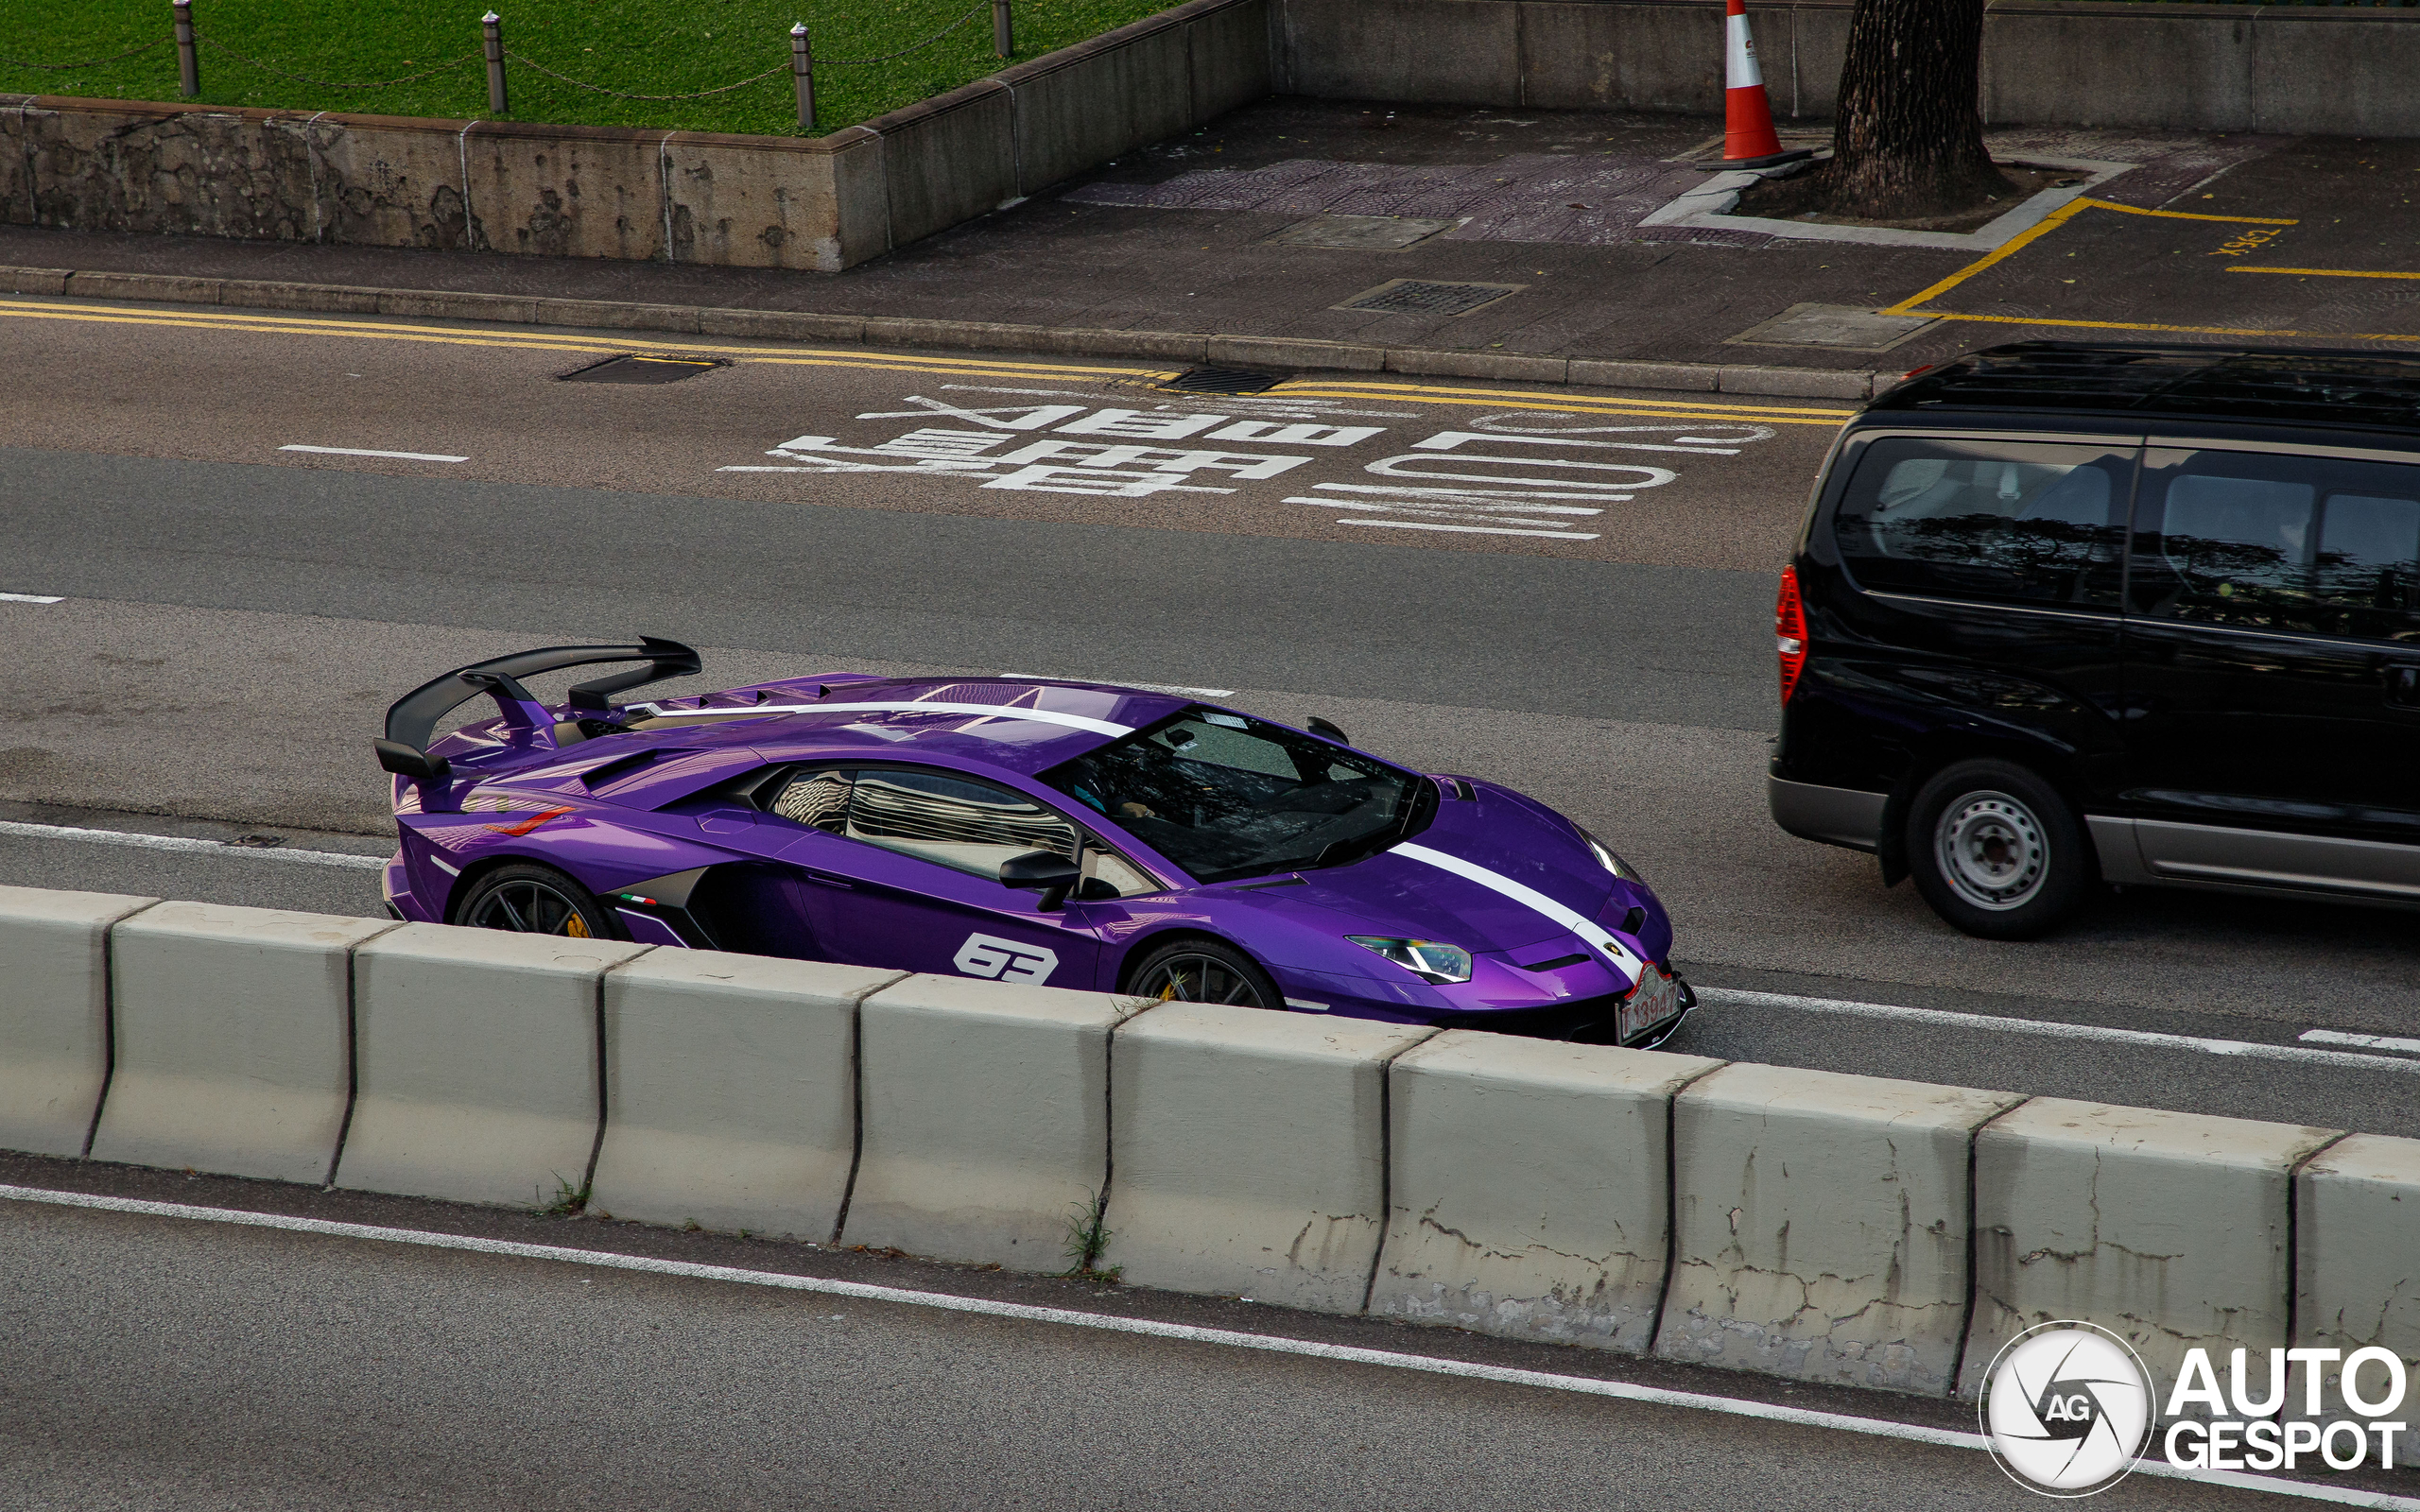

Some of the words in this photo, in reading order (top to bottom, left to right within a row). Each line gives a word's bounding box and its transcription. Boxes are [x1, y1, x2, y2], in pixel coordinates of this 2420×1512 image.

[715, 385, 1420, 497] 慢駛
[1281, 412, 1777, 540] SLOW
[953, 932, 1059, 986] 63
